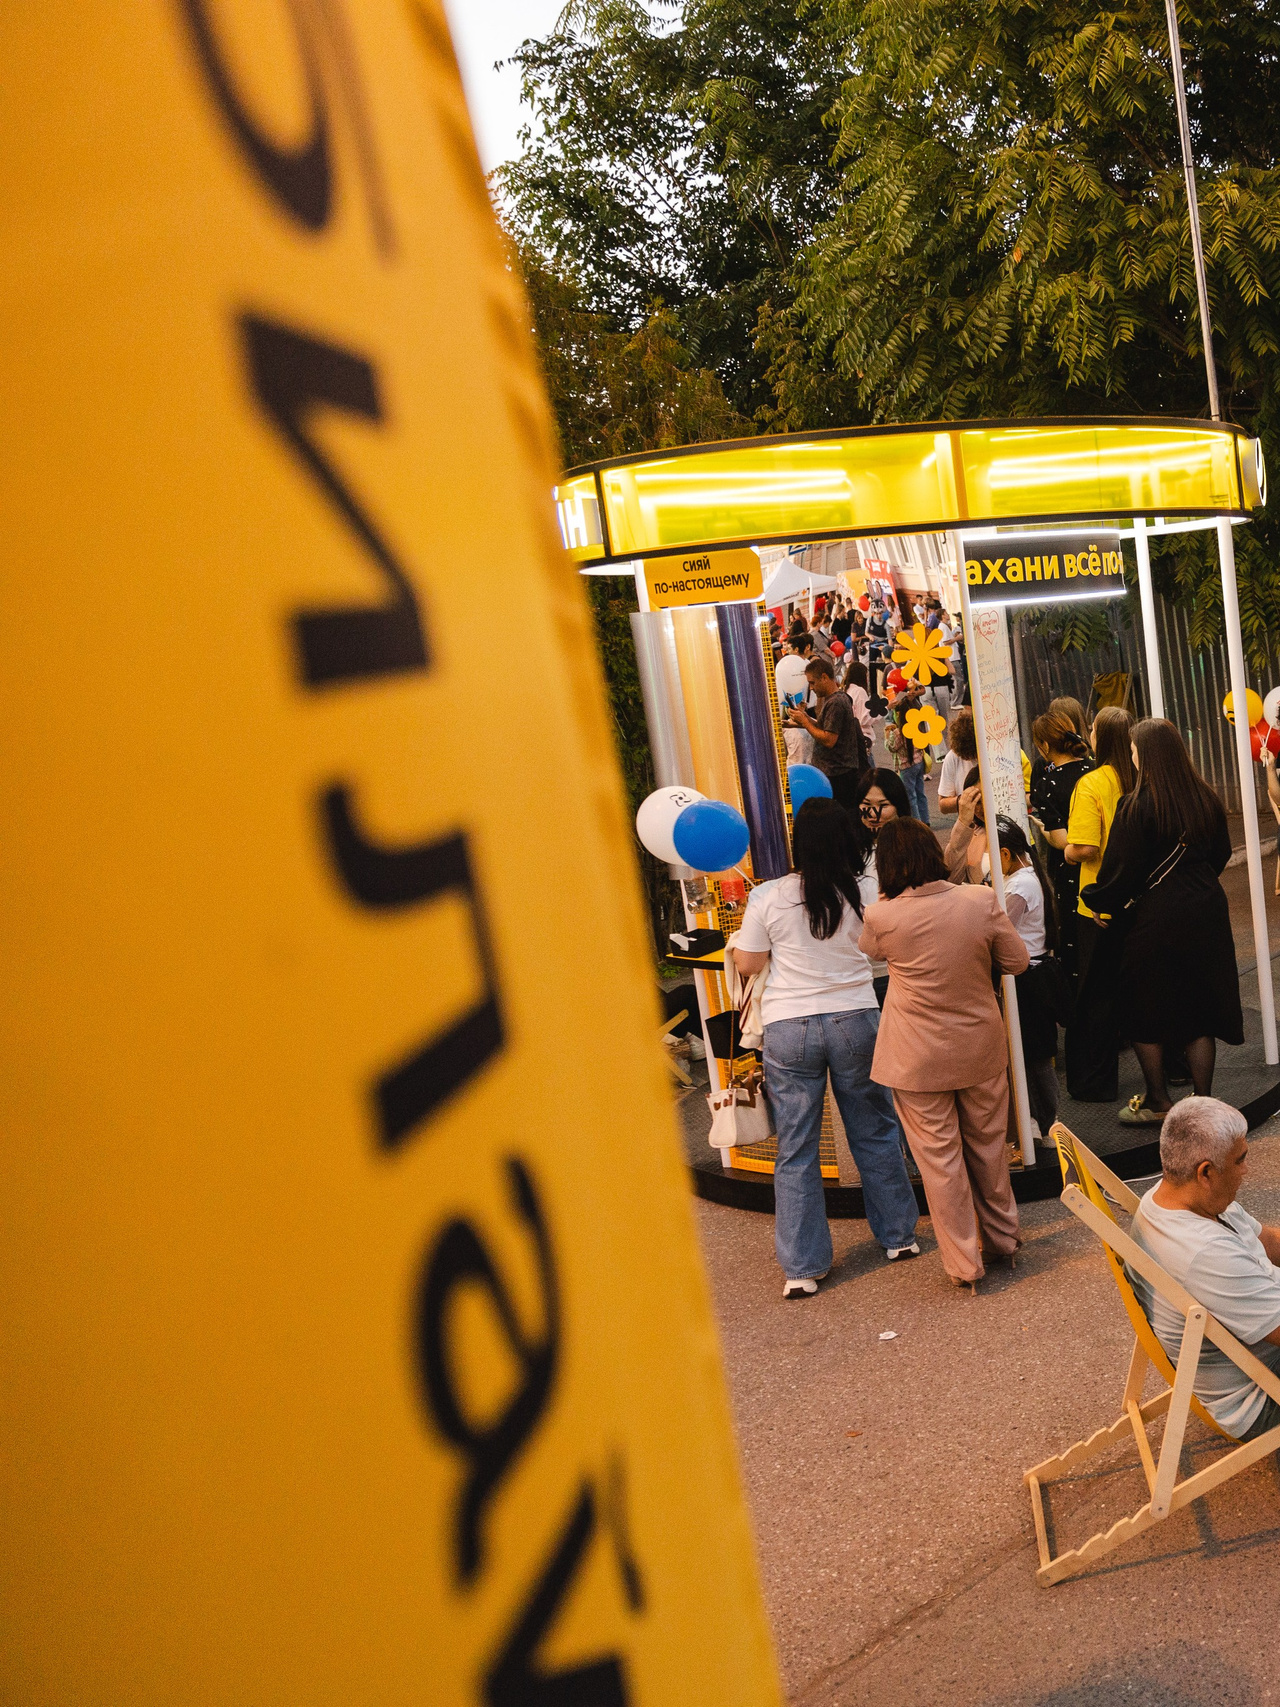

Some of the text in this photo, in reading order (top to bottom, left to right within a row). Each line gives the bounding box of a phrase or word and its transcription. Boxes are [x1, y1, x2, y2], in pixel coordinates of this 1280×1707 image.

[682, 555, 711, 573] сияй
[965, 554, 1060, 586] ахани
[1063, 544, 1101, 578] всё
[654, 572, 750, 595] по-настоящему
